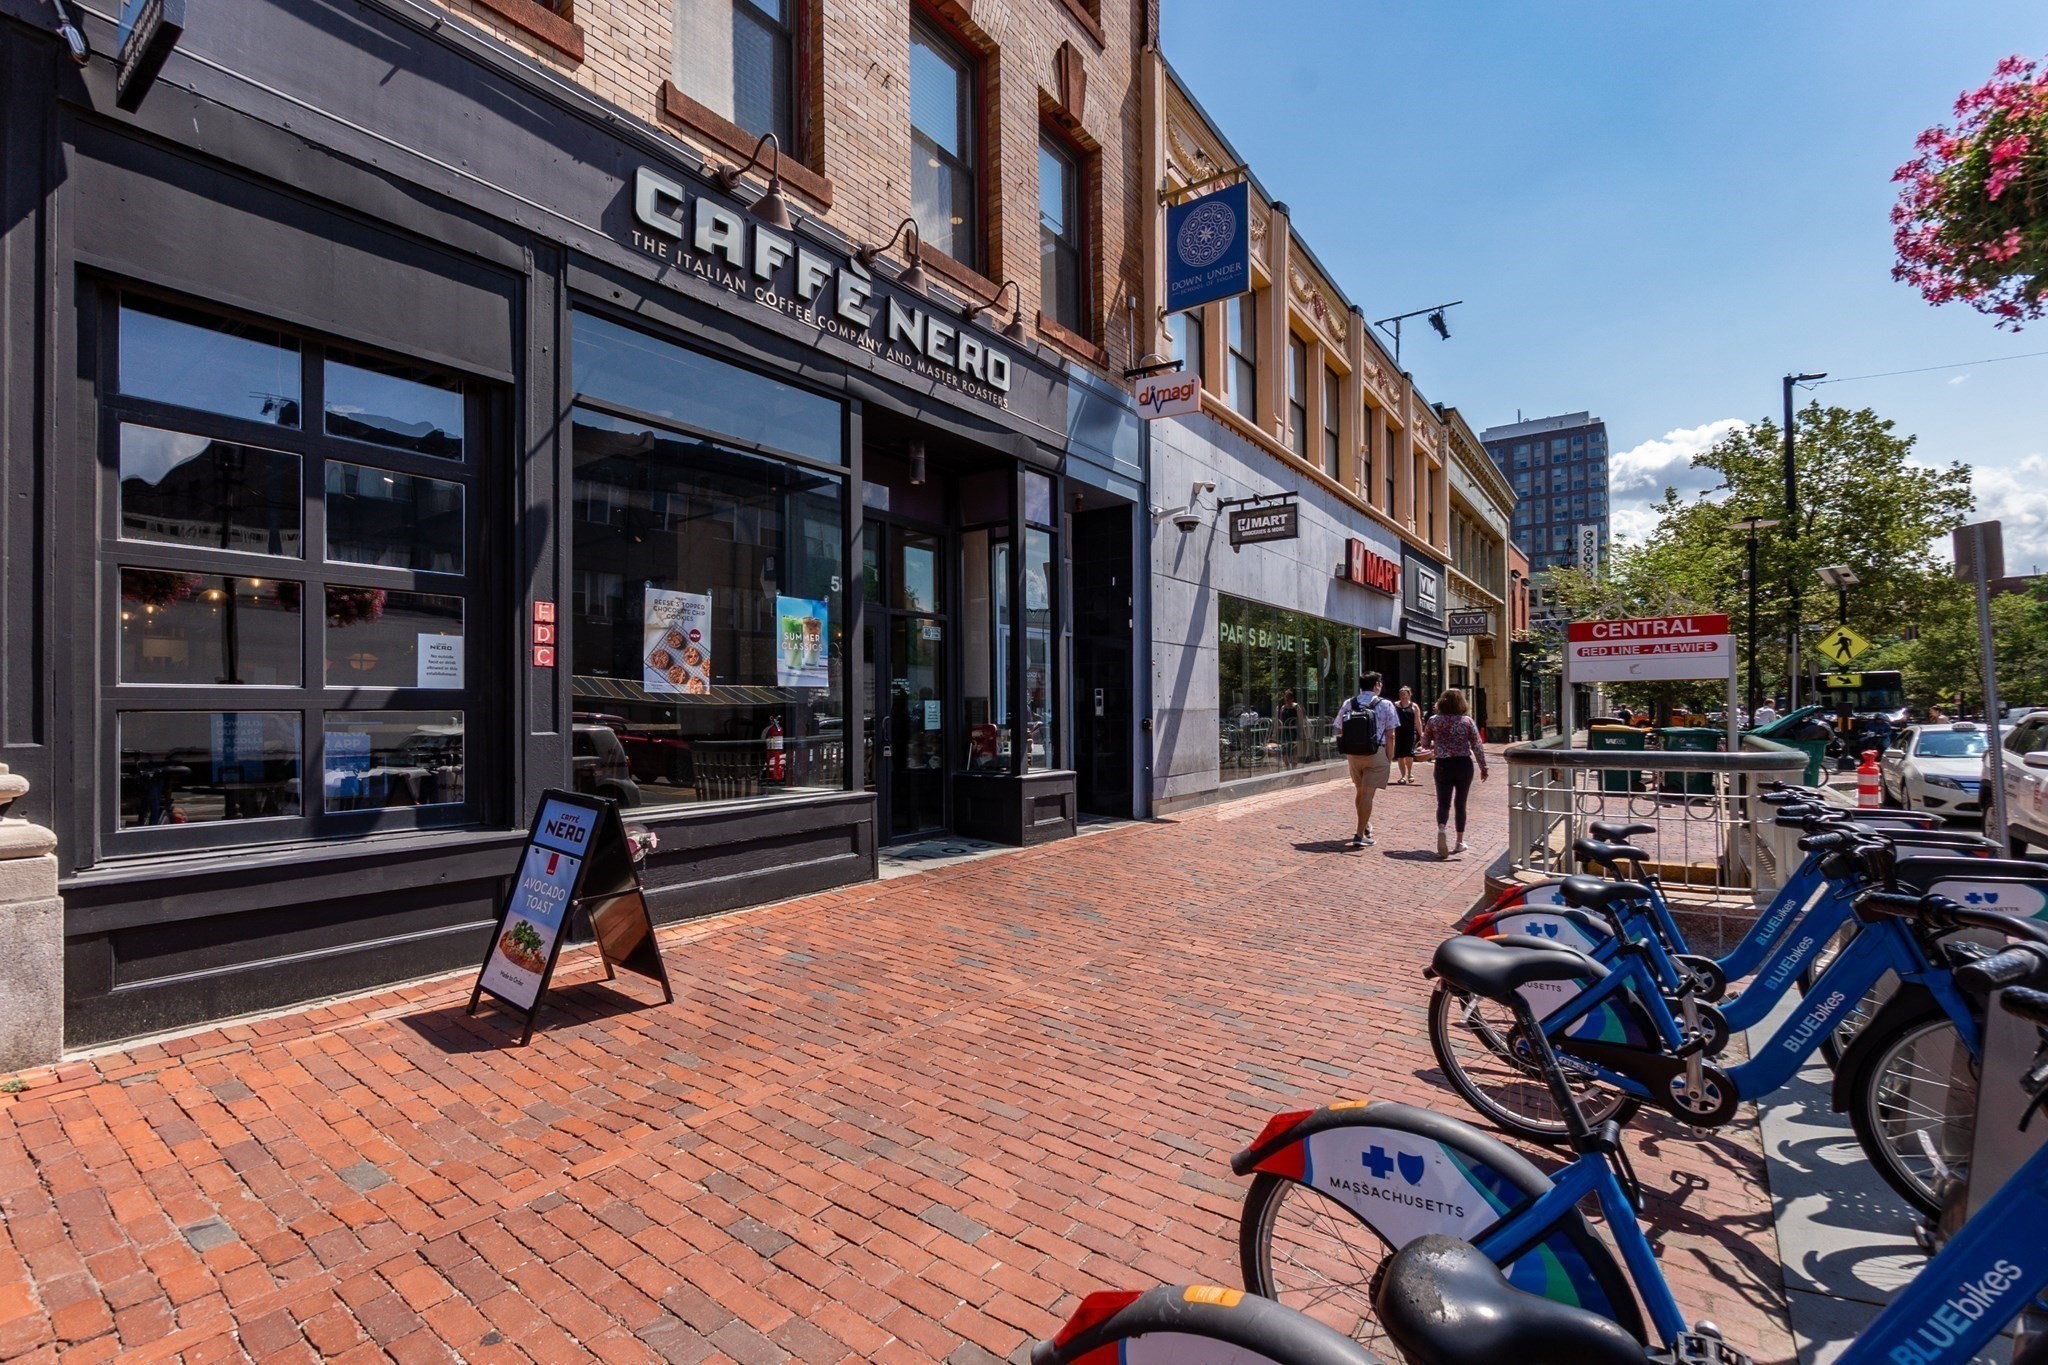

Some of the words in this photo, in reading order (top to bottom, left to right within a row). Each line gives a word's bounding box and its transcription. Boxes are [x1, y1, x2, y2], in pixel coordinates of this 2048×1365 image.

[634, 164, 874, 329] CAFFÈ
[886, 294, 1012, 392] NERO
[1171, 274, 1202, 291] DOWN
[1207, 262, 1242, 280] UNDER
[631, 229, 667, 259] THE
[676, 248, 747, 294] ITALIAN
[753, 286, 812, 324] COFFEE
[817, 315, 883, 355] COMPANY
[885, 346, 913, 367] AND
[915, 359, 959, 387] MASTER
[962, 379, 1010, 410] ROASTERS
[1251, 514, 1288, 528] MART
[1365, 551, 1400, 595] MART
[653, 605, 691, 616] CHOCOLATE
[666, 613, 694, 622] COOKIES
[681, 602, 705, 611] TOPPED
[1452, 617, 1484, 625] VIM
[1592, 618, 1700, 638] CENTRAL
[784, 632, 820, 642] SUMMER
[1220, 622, 1256, 647] PARS
[781, 641, 823, 652] CLASSICS
[1581, 647, 1608, 657] RED
[1611, 645, 1640, 656] LINE
[1652, 642, 1714, 653] ALEWIFE
[334, 739, 361, 749] APP
[545, 820, 586, 843] NERO
[524, 878, 566, 901] AVOCADO
[526, 894, 554, 915] TOAST
[1755, 898, 1797, 946] BLUEbikes
[1764, 936, 1815, 990] BLUEbikes
[1782, 991, 1846, 1053] BLUEbikes
[1330, 1177, 1465, 1218] MASSACHUSETTS
[1888, 1259, 2023, 1365] BLUEbikes
